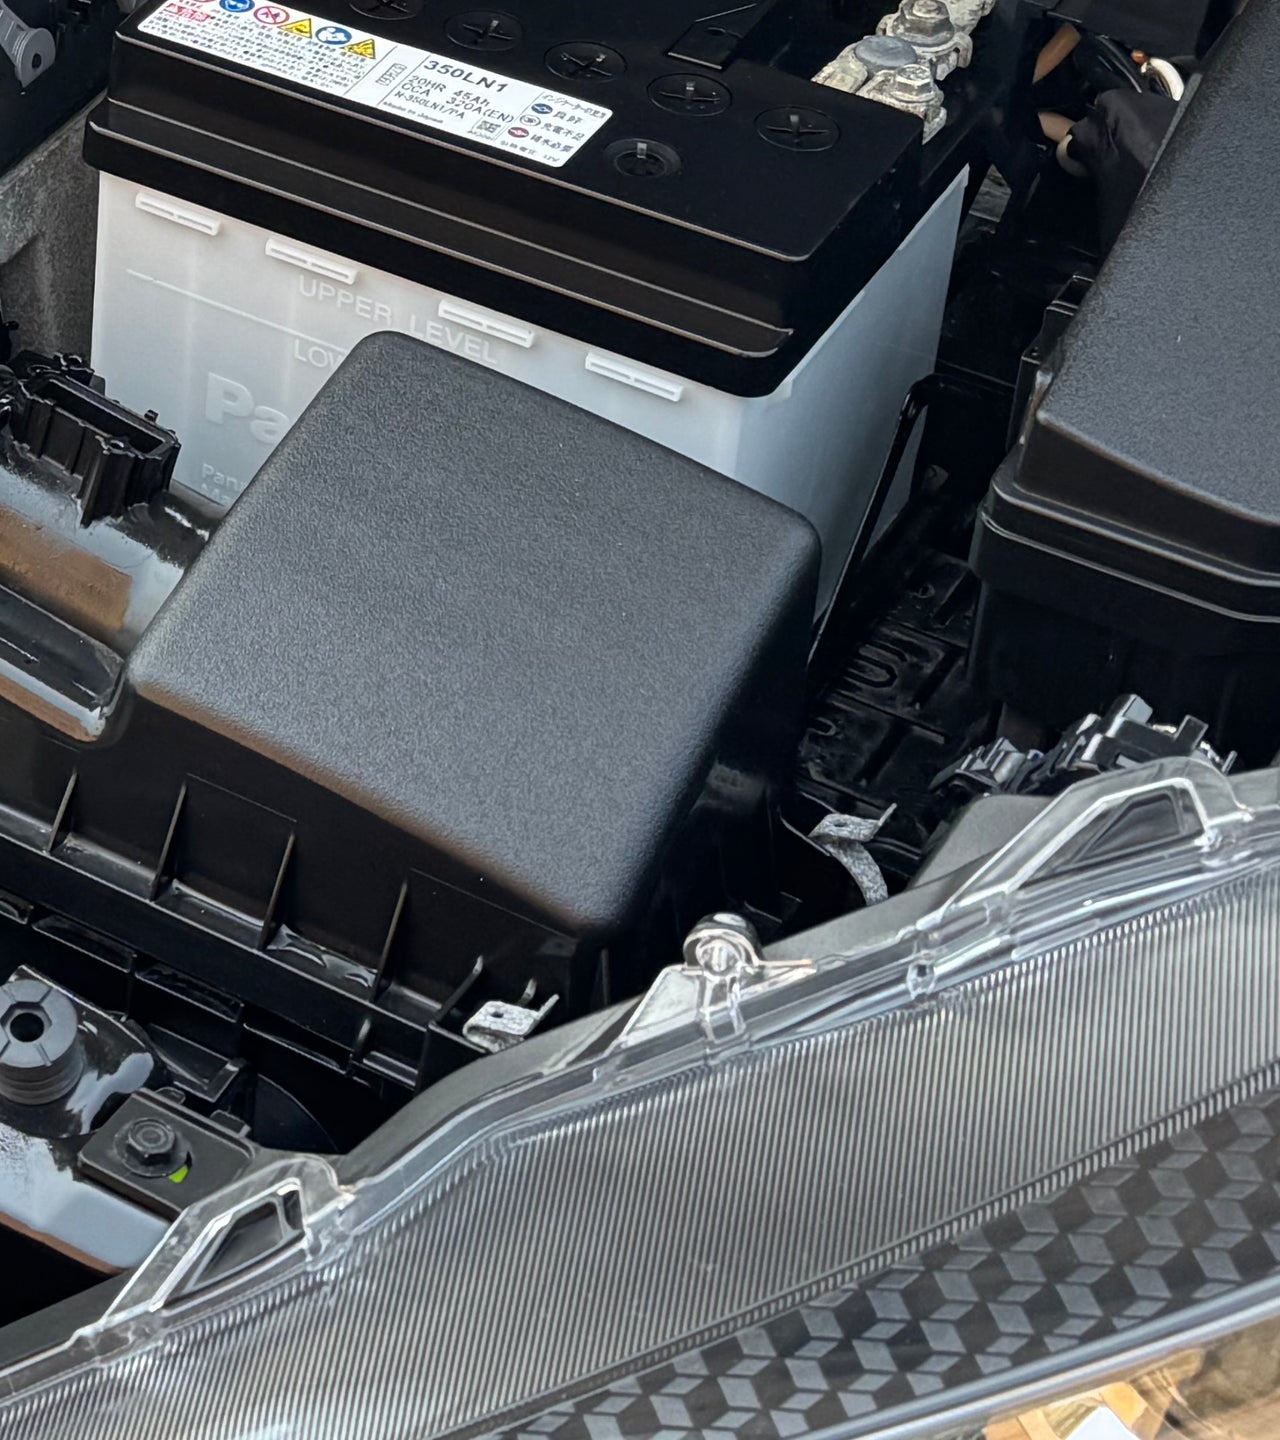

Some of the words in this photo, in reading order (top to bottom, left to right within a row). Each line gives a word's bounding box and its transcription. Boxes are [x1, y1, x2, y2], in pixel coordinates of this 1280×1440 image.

[408, 75, 447, 92] 20HR
[453, 90, 490, 107] 45Ah
[424, 60, 508, 92] 350LN1
[401, 82, 431, 97] CCA
[446, 97, 515, 123] 320A(EN)
[299, 275, 391, 325] UPPER
[409, 314, 498, 364] LEVEL
